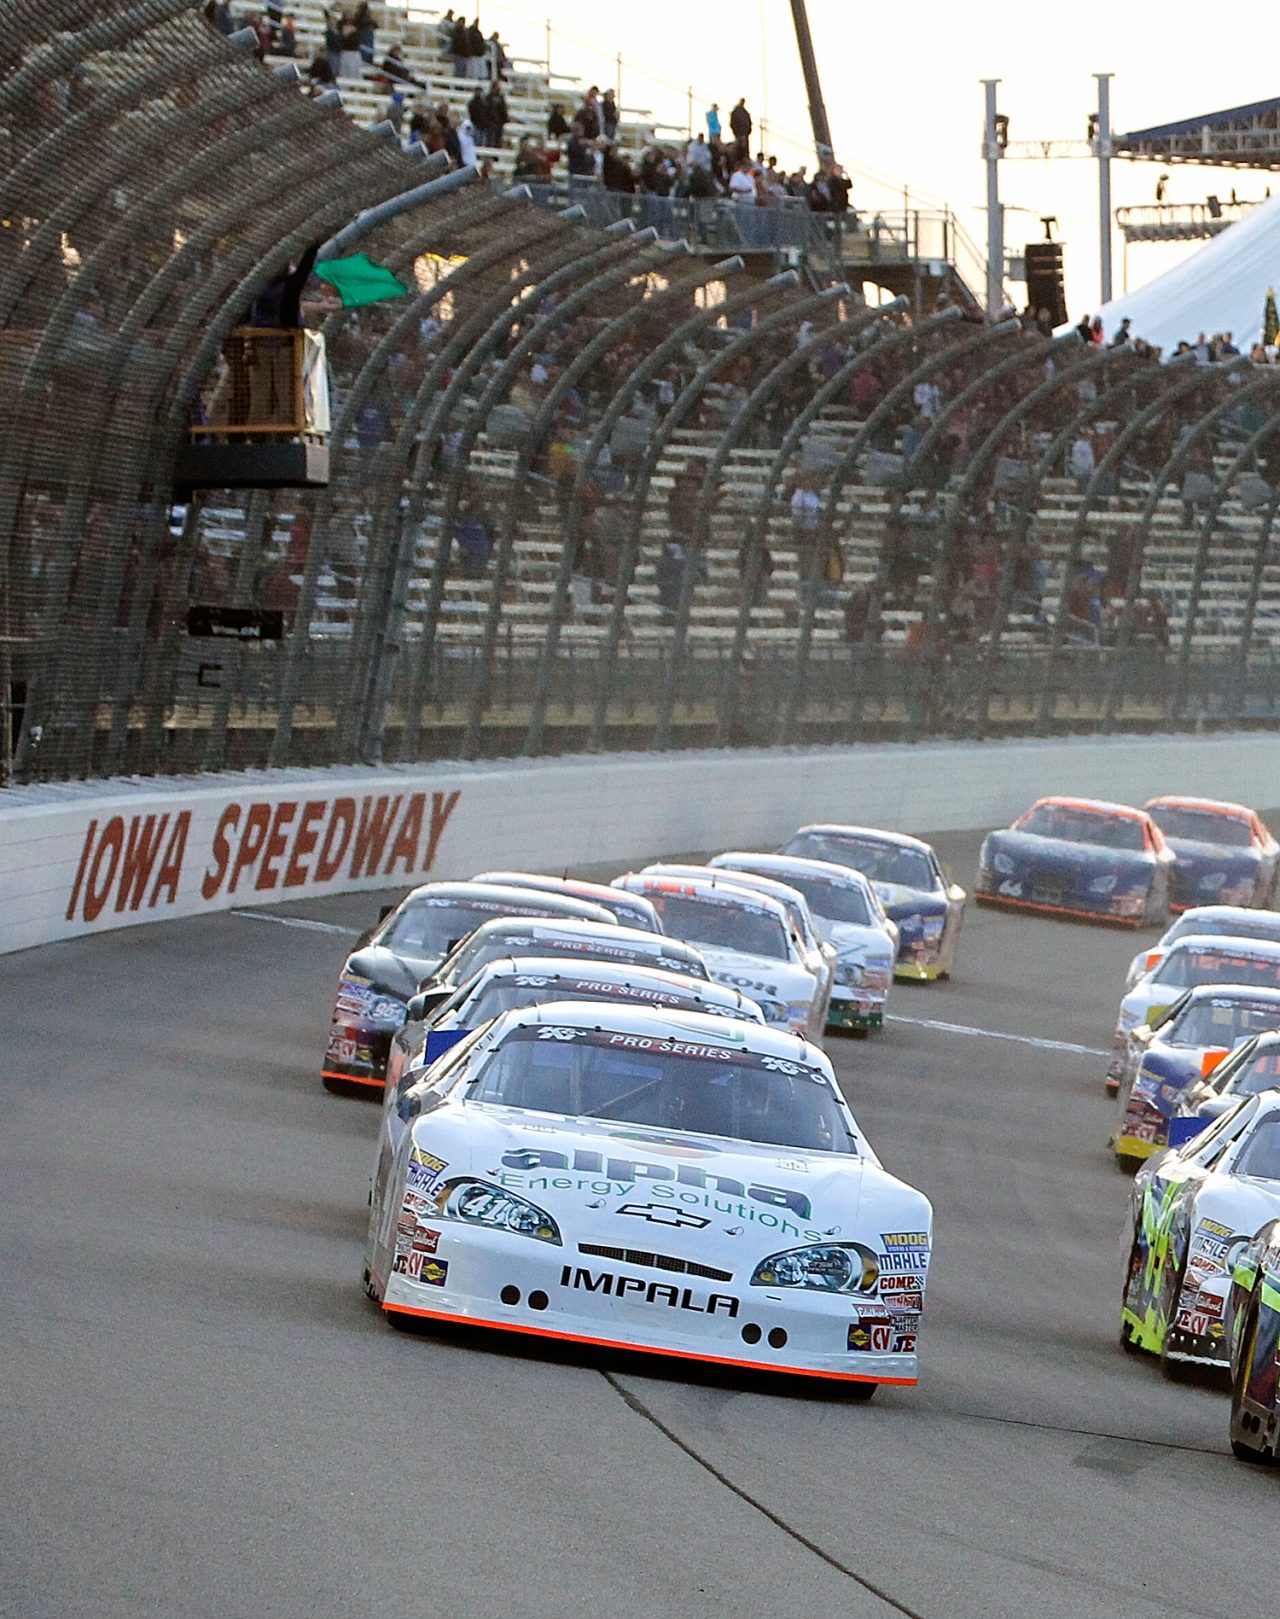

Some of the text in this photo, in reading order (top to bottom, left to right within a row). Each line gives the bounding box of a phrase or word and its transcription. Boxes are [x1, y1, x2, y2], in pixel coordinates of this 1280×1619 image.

[65, 790, 462, 922] IOWA SPEEDWAY
[576, 980, 680, 1004] PRO SERIES
[609, 1034, 733, 1061] PRO SERIES
[501, 1147, 812, 1221] alpha
[463, 1194, 509, 1222] 41
[500, 1173, 823, 1242] Energy Solutions
[883, 1234, 927, 1246] MOOG
[880, 1253, 927, 1270] MAHLE
[560, 1265, 740, 1319] IMPALA
[880, 1276, 915, 1290] COMP
[872, 1327, 892, 1350] CV
[892, 1335, 917, 1352] JE
